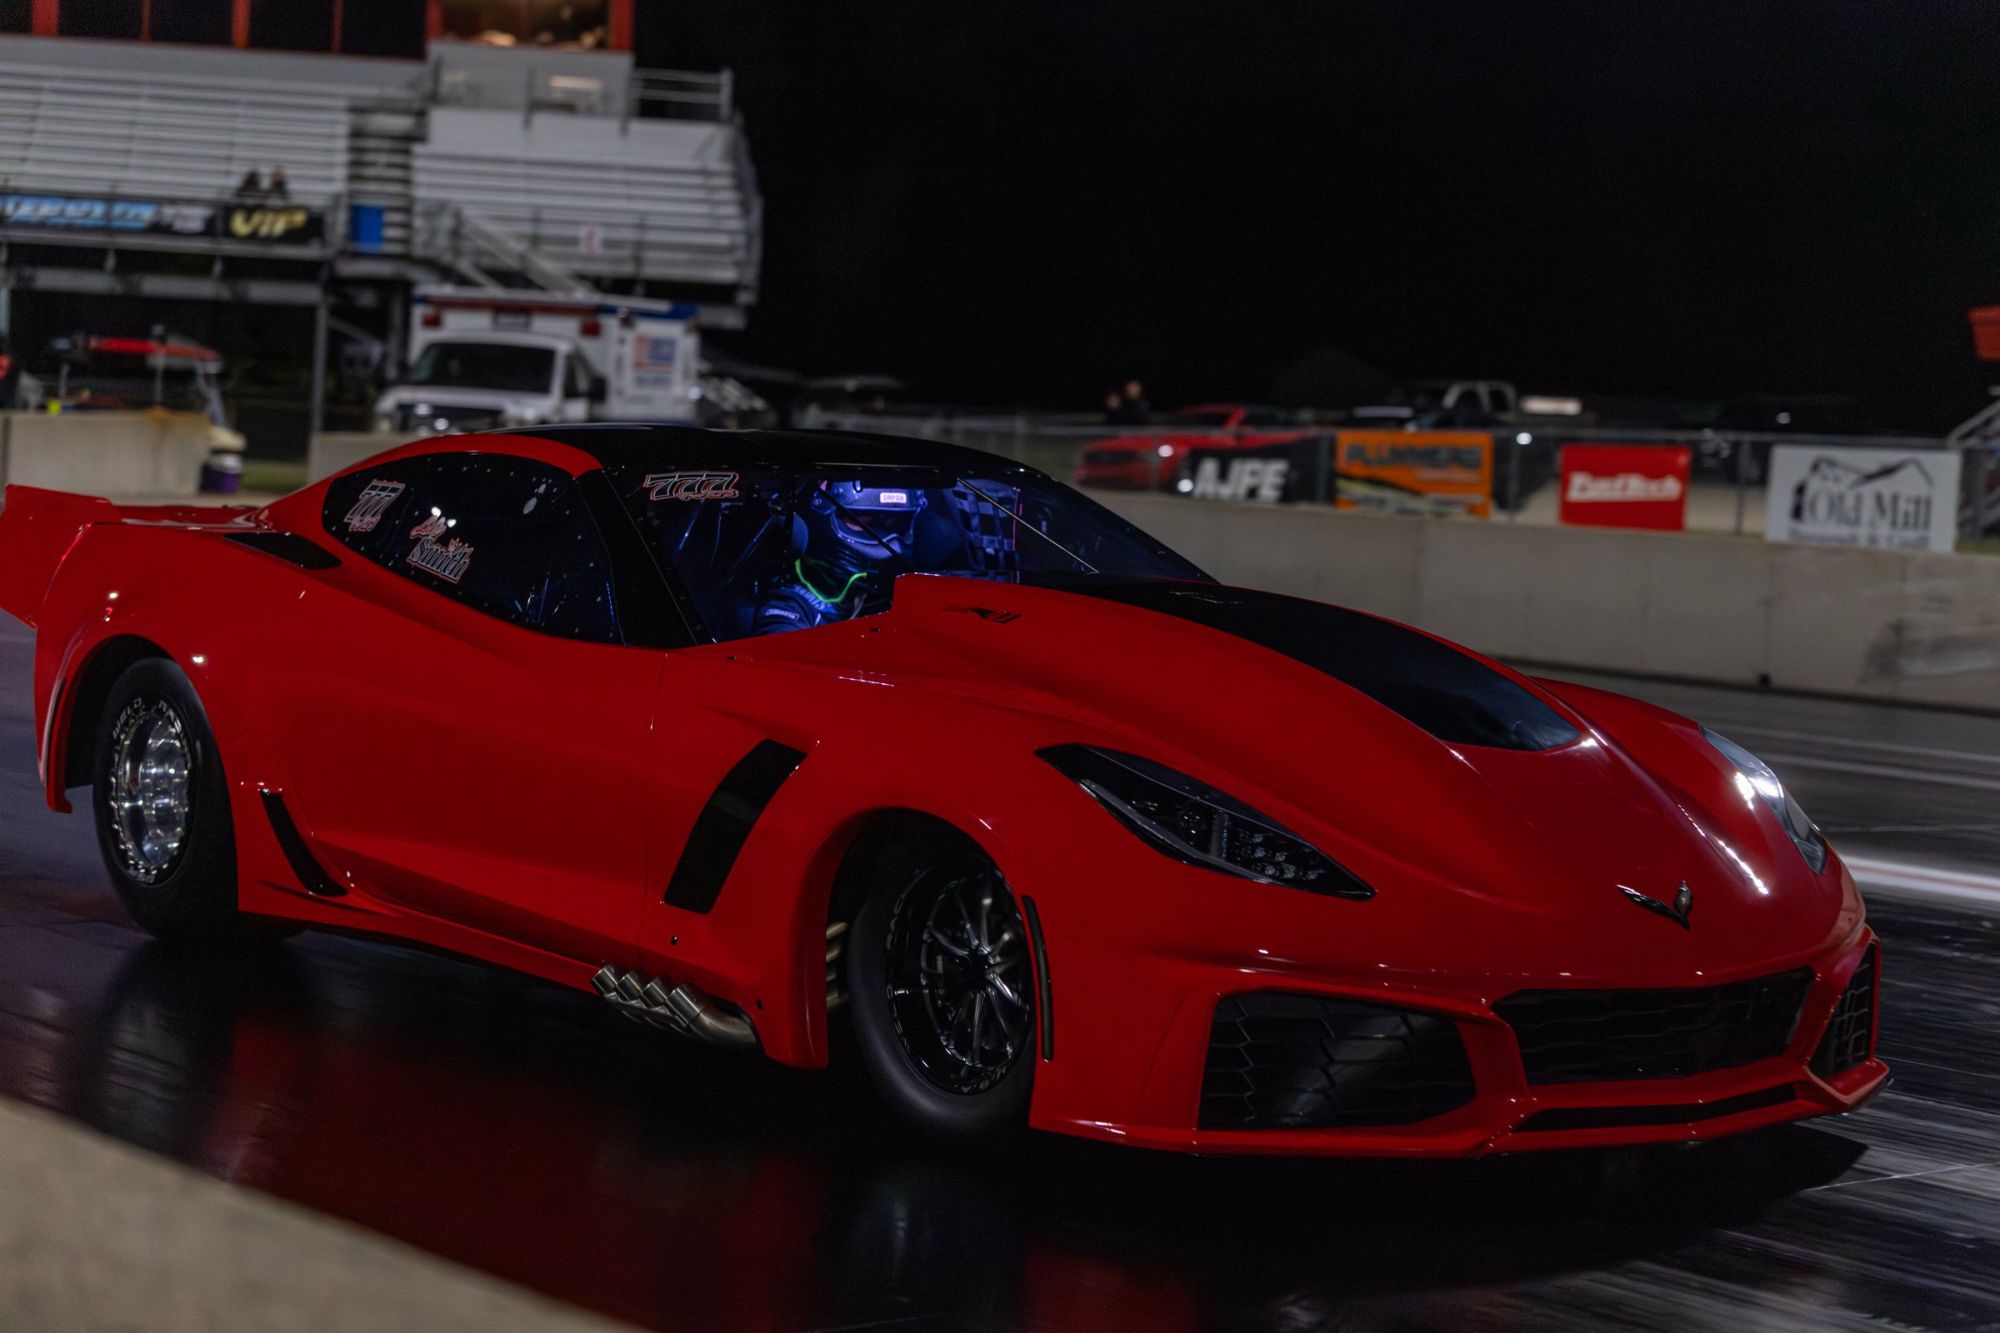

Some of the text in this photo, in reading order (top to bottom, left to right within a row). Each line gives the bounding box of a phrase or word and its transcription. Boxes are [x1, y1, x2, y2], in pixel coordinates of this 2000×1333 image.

[230, 204, 309, 238] VIP
[642, 470, 742, 501] 777
[1808, 490, 1932, 532] Old Mill
